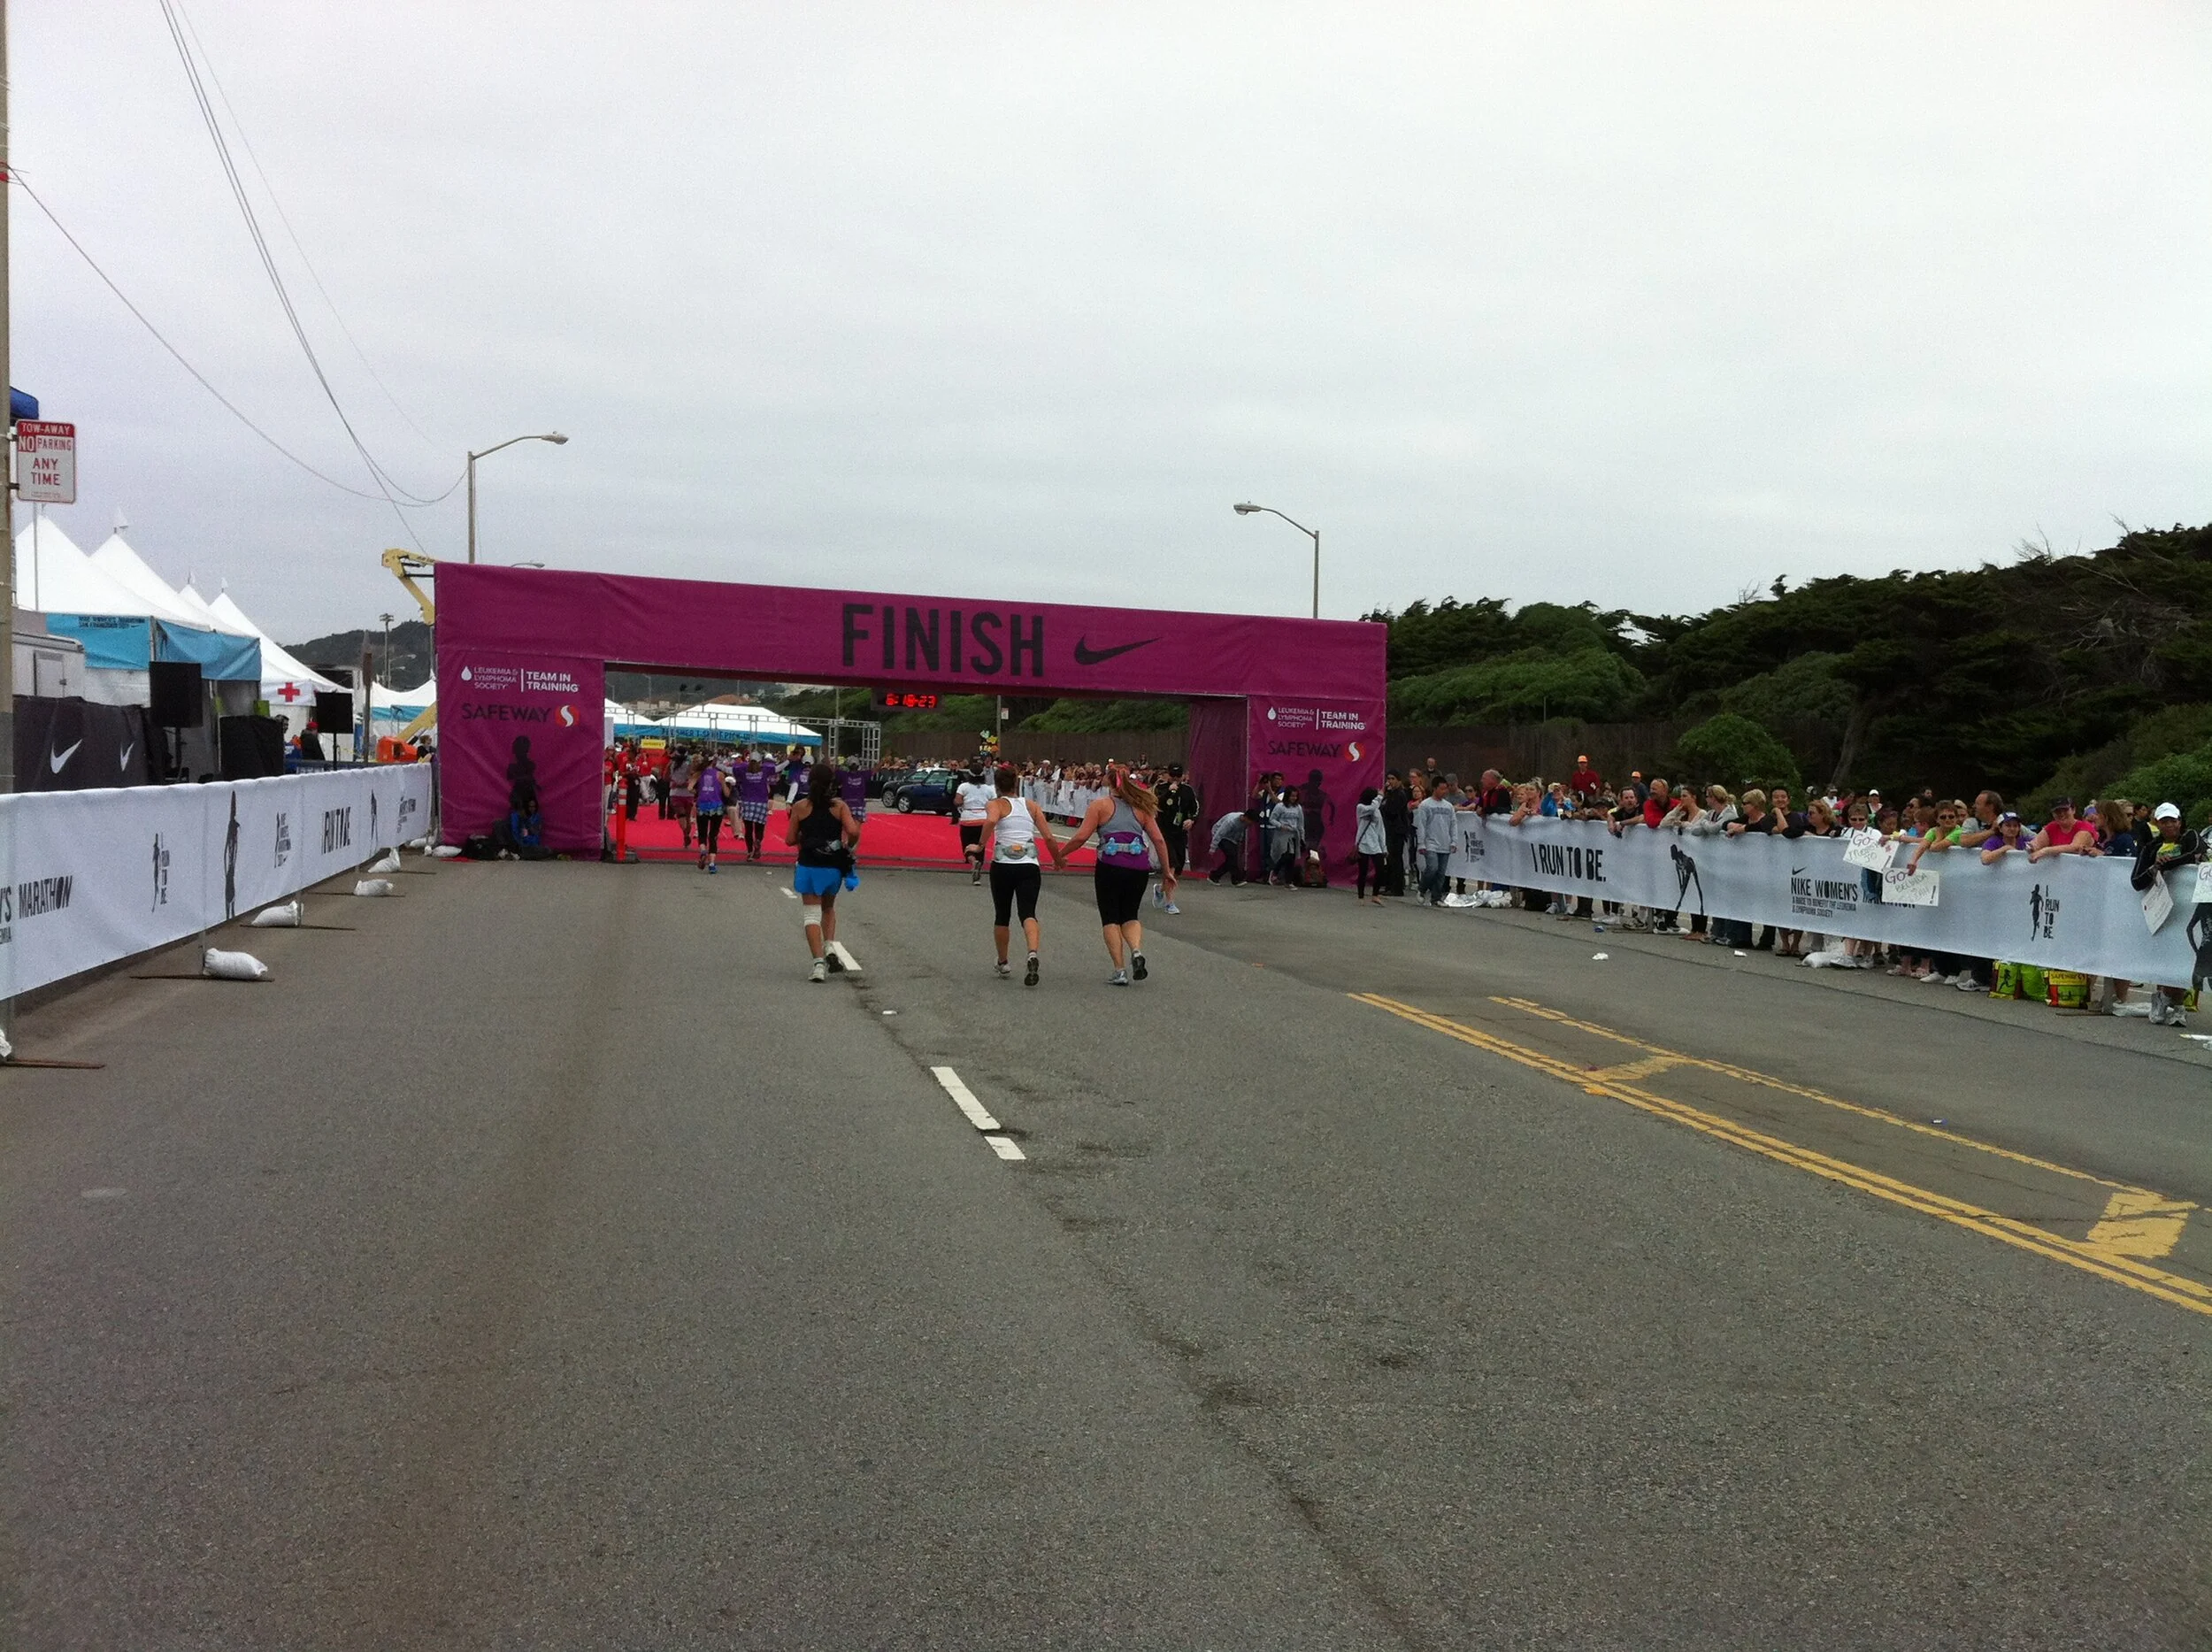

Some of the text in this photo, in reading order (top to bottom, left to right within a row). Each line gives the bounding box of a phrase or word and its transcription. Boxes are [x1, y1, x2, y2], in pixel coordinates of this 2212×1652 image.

[21, 422, 71, 435] TOW-AWAY
[18, 436, 72, 451] NO PARKING
[33, 457, 58, 471] ANY
[31, 472, 60, 486] TIME
[842, 603, 1044, 678] FINISH
[473, 666, 511, 675] LEUKEMIA
[526, 671, 572, 682] TEAM IN
[473, 674, 517, 683] LYMPHOMA
[526, 680, 579, 693] TRAINING
[462, 703, 550, 722] SAFEWAY
[1321, 711, 1359, 721] TEAM IN
[1321, 719, 1365, 731] TRAINING
[1268, 741, 1340, 757] SAFEWAY
[1531, 843, 1607, 882] I RUN TO BE.
[19, 875, 73, 919] MARATHON
[1791, 877, 1811, 896] NIKE
[1815, 880, 1858, 903] WOMEN'S
[2046, 885, 2048, 897] I
[2045, 899, 2060, 912] RUN
[2045, 912, 2054, 926] TO
